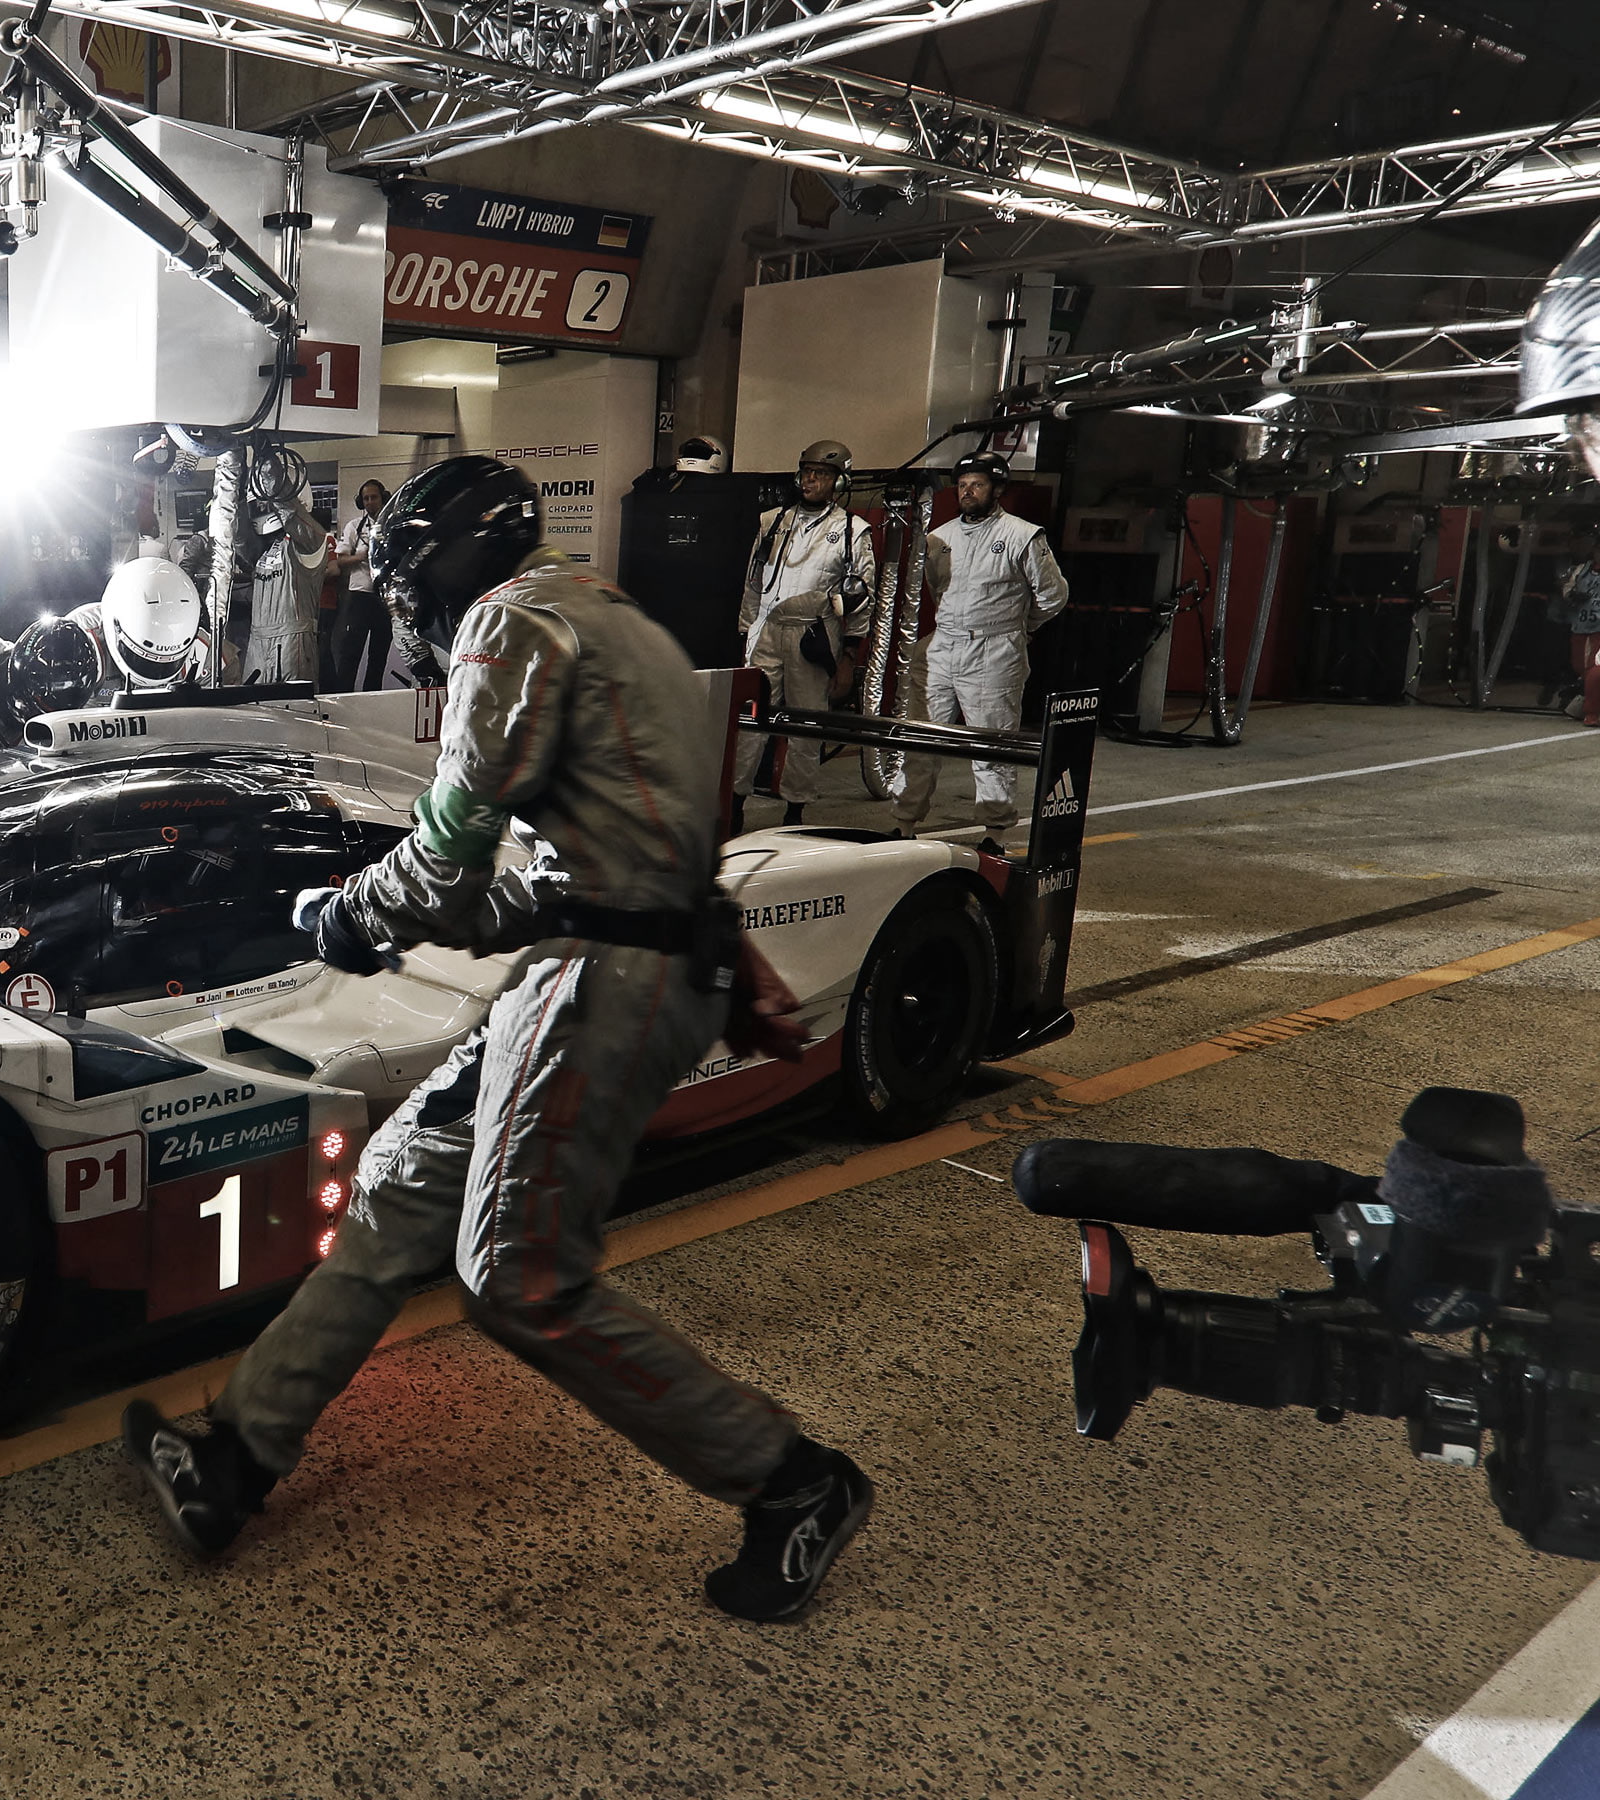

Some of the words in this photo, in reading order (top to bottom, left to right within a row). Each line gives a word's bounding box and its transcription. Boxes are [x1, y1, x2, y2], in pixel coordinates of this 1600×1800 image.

[477, 200, 526, 231] LMP1
[526, 211, 575, 236] HYBRID
[582, 280, 611, 323] 2
[315, 351, 335, 399] 1
[660, 414, 674, 431] 24
[495, 444, 598, 459] PORSCHE
[541, 480, 595, 497] MORI
[548, 505, 593, 513] CHOPARD
[547, 526, 592, 534] SCHAEFFLER
[156, 643, 183, 653] uvex
[69, 718, 127, 742] Mobil
[1041, 798, 1079, 818] adidas
[1038, 871, 1063, 898] Mobil
[738, 895, 846, 931] HAEFFLER
[207, 992, 222, 1003] Jani
[236, 984, 265, 997] Lotterer
[277, 978, 298, 989] Tandy
[140, 1083, 257, 1125] CHOPARD
[160, 1131, 204, 1165] 24h
[208, 1131, 236, 1153] LE
[238, 1116, 300, 1145] MANS
[65, 1149, 128, 1213] P1
[199, 1174, 241, 1292] 1
